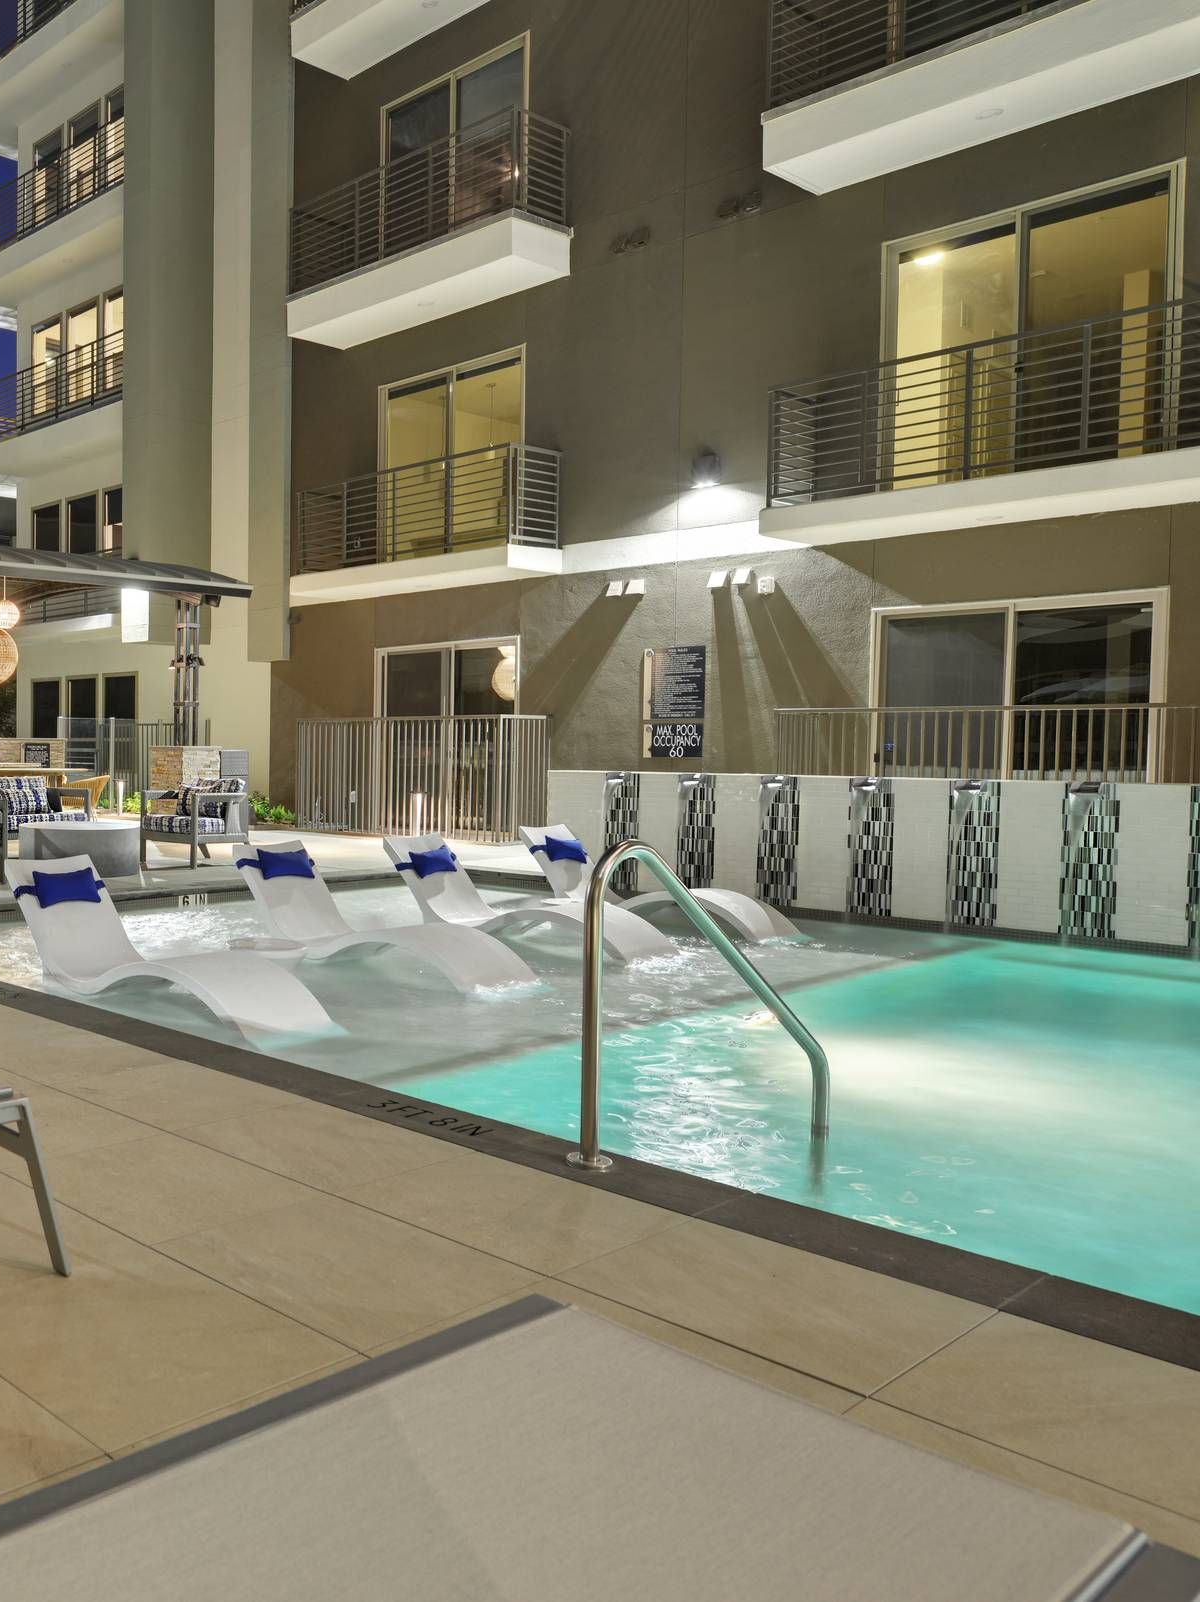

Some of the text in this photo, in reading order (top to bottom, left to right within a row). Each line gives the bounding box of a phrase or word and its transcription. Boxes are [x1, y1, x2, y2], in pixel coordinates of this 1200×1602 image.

[656, 724, 698, 736] MAX. POOL
[653, 735, 701, 747] OCCUPANCY
[669, 747, 684, 758] 60
[182, 894, 205, 906] 6 IN
